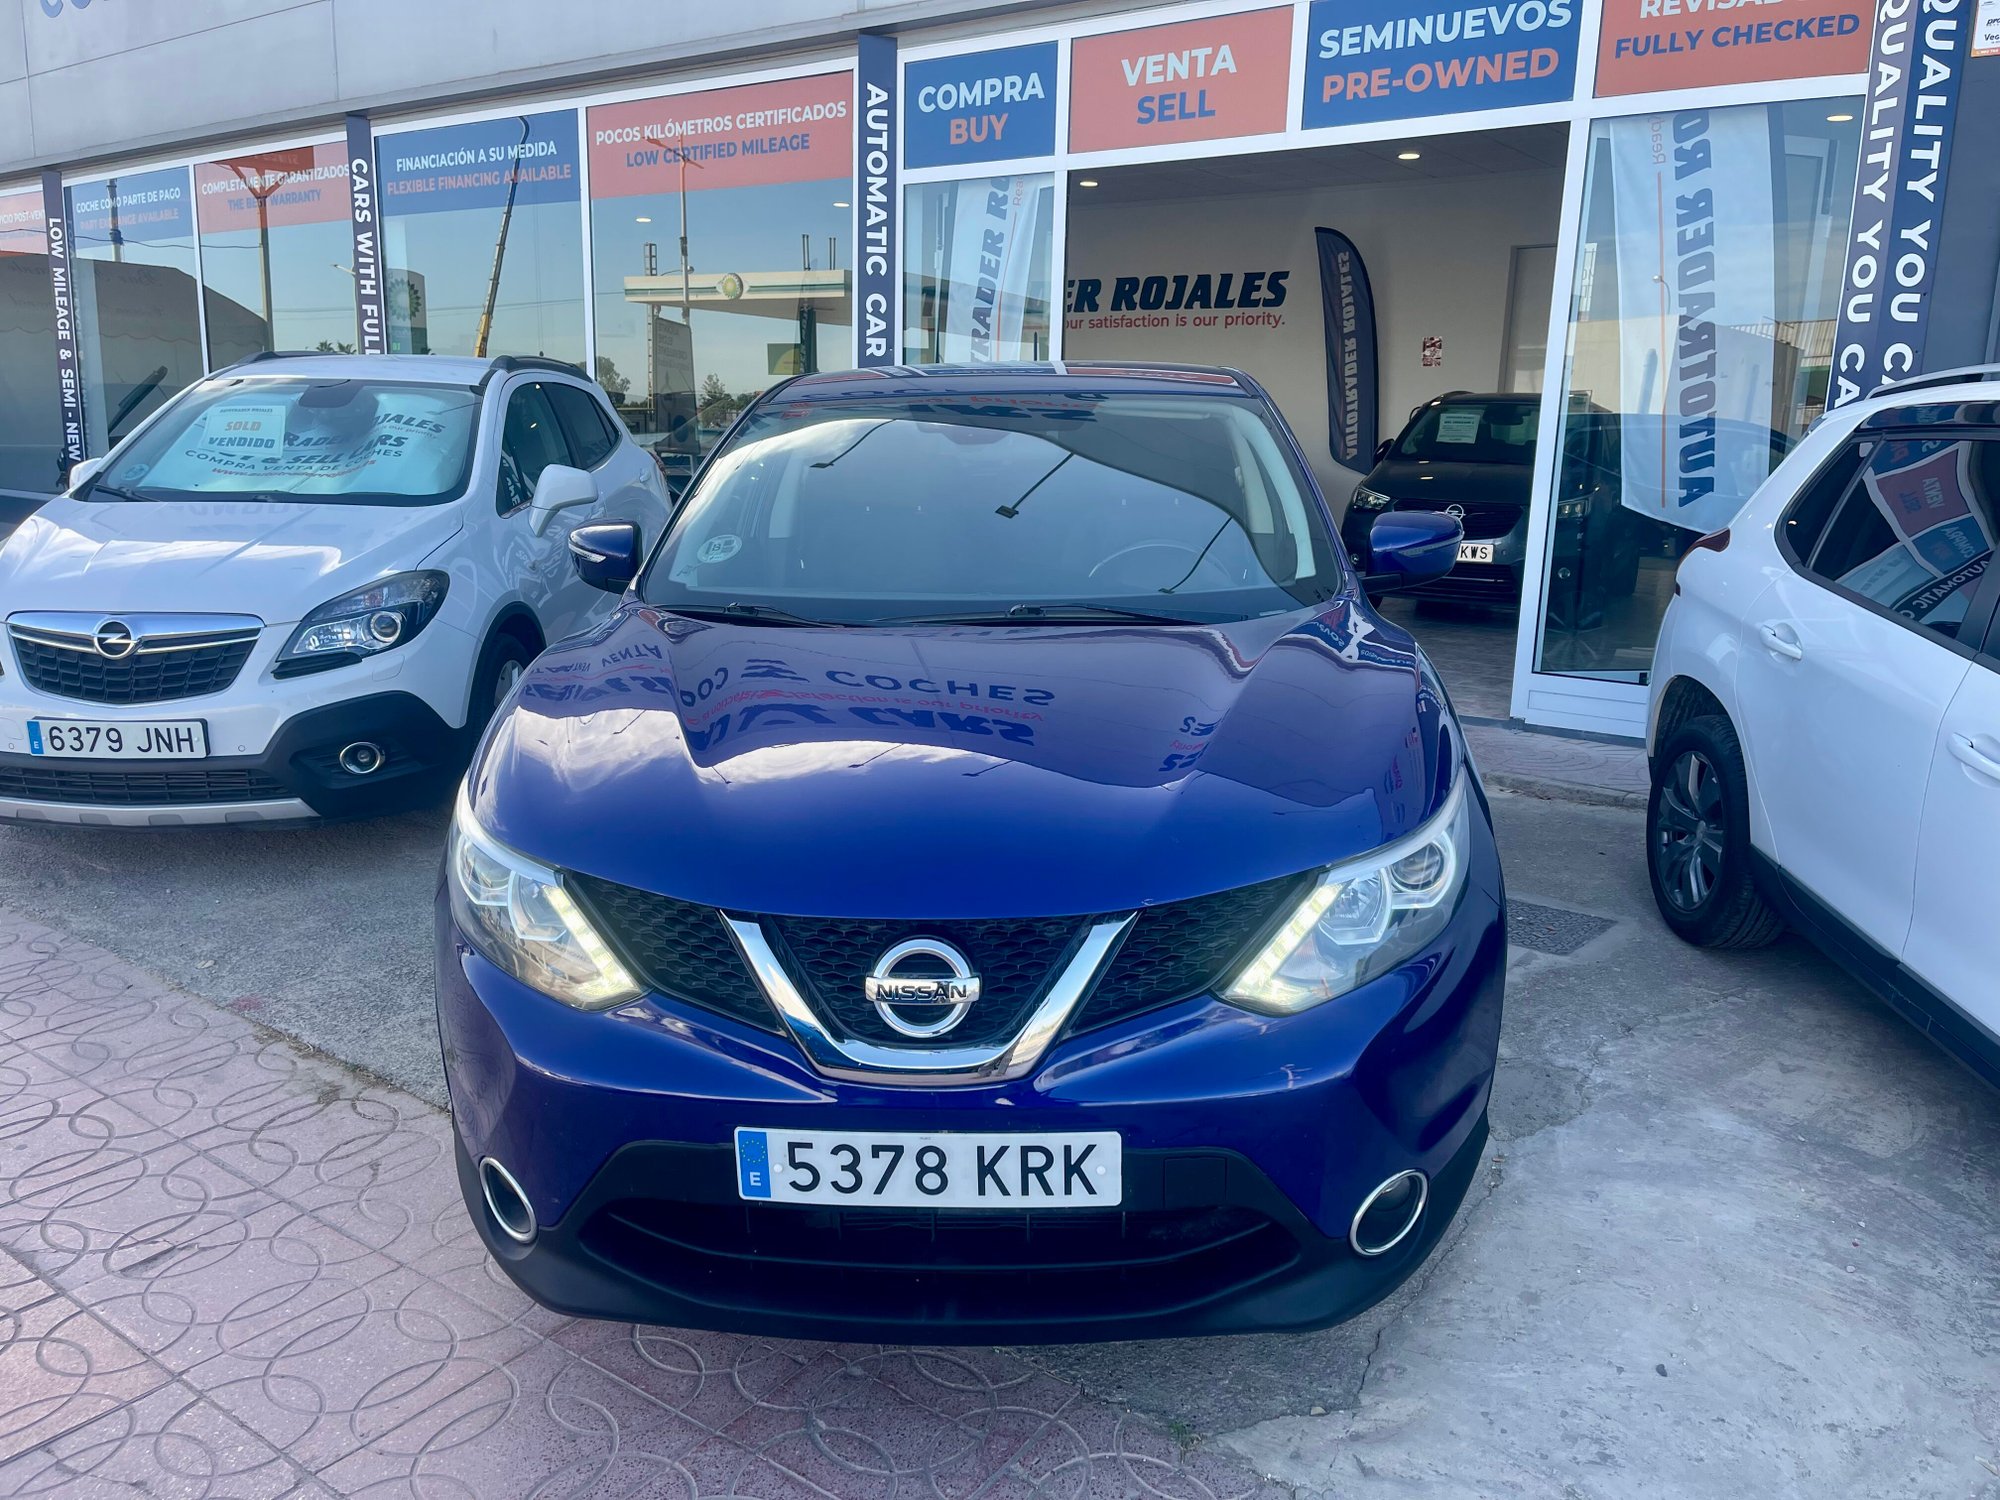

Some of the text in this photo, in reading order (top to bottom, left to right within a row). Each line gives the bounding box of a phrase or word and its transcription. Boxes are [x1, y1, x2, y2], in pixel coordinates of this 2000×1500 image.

[1640, 0, 1783, 18] REVI
[1318, 0, 1572, 59] SEMINUEVOS
[1614, 13, 1860, 59] FULLY CHECKED
[1121, 44, 1237, 87] VENTA
[1322, 47, 1559, 103] PRE-OWNED
[918, 72, 1045, 113] COMPRA
[1136, 89, 1216, 125] SELL
[596, 100, 847, 145] POCOS KILÓMETROS CERTIFICADOS
[949, 113, 1008, 145] BUY
[396, 141, 557, 172] FINANCIACIÓN A SU MEDIDA
[626, 133, 810, 168] LOW CERTIFIED MILEAGE
[202, 164, 349, 195] COMPLETAMENTE GARANTIZADOS
[351, 158, 372, 223] CARS
[387, 164, 571, 196] FLEXIBLE FINANCING AVAILABLE
[76, 187, 181, 213] COCHE COMO PARTE DE PAGO
[227, 199, 245, 211] THE
[271, 189, 321, 206] WARRANTY
[99, 214, 137, 229] EXANGE
[865, 82, 888, 357] AUTOMATIC CAR
[49, 218, 63, 258] LOW
[357, 231, 376, 295] WITH
[1846, 219, 1883, 323] YOU
[1889, 219, 1931, 323] YOU
[53, 267, 70, 341] MILEAGE
[1110, 270, 1290, 312] ROJALES
[1088, 314, 1170, 330] satisfaction
[1175, 313, 1187, 327] is
[1193, 315, 1218, 327] our
[1224, 312, 1286, 329] priority.
[59, 349, 72, 360] &
[1881, 343, 1913, 385] C
[61, 368, 76, 408] SEMI
[66, 422, 81, 461] NEW
[208, 437, 275, 449] VENDIDO
[225, 421, 262, 431] SOLD
[185, 450, 255, 469] COMPRA
[286, 453, 344, 464] SELL
[1460, 545, 1488, 560] KWS
[48, 726, 194, 753] 6379 JNH
[876, 983, 967, 1000] NISSAN
[749, 1171, 762, 1186] E
[786, 1141, 1098, 1196] 5378 KRK
